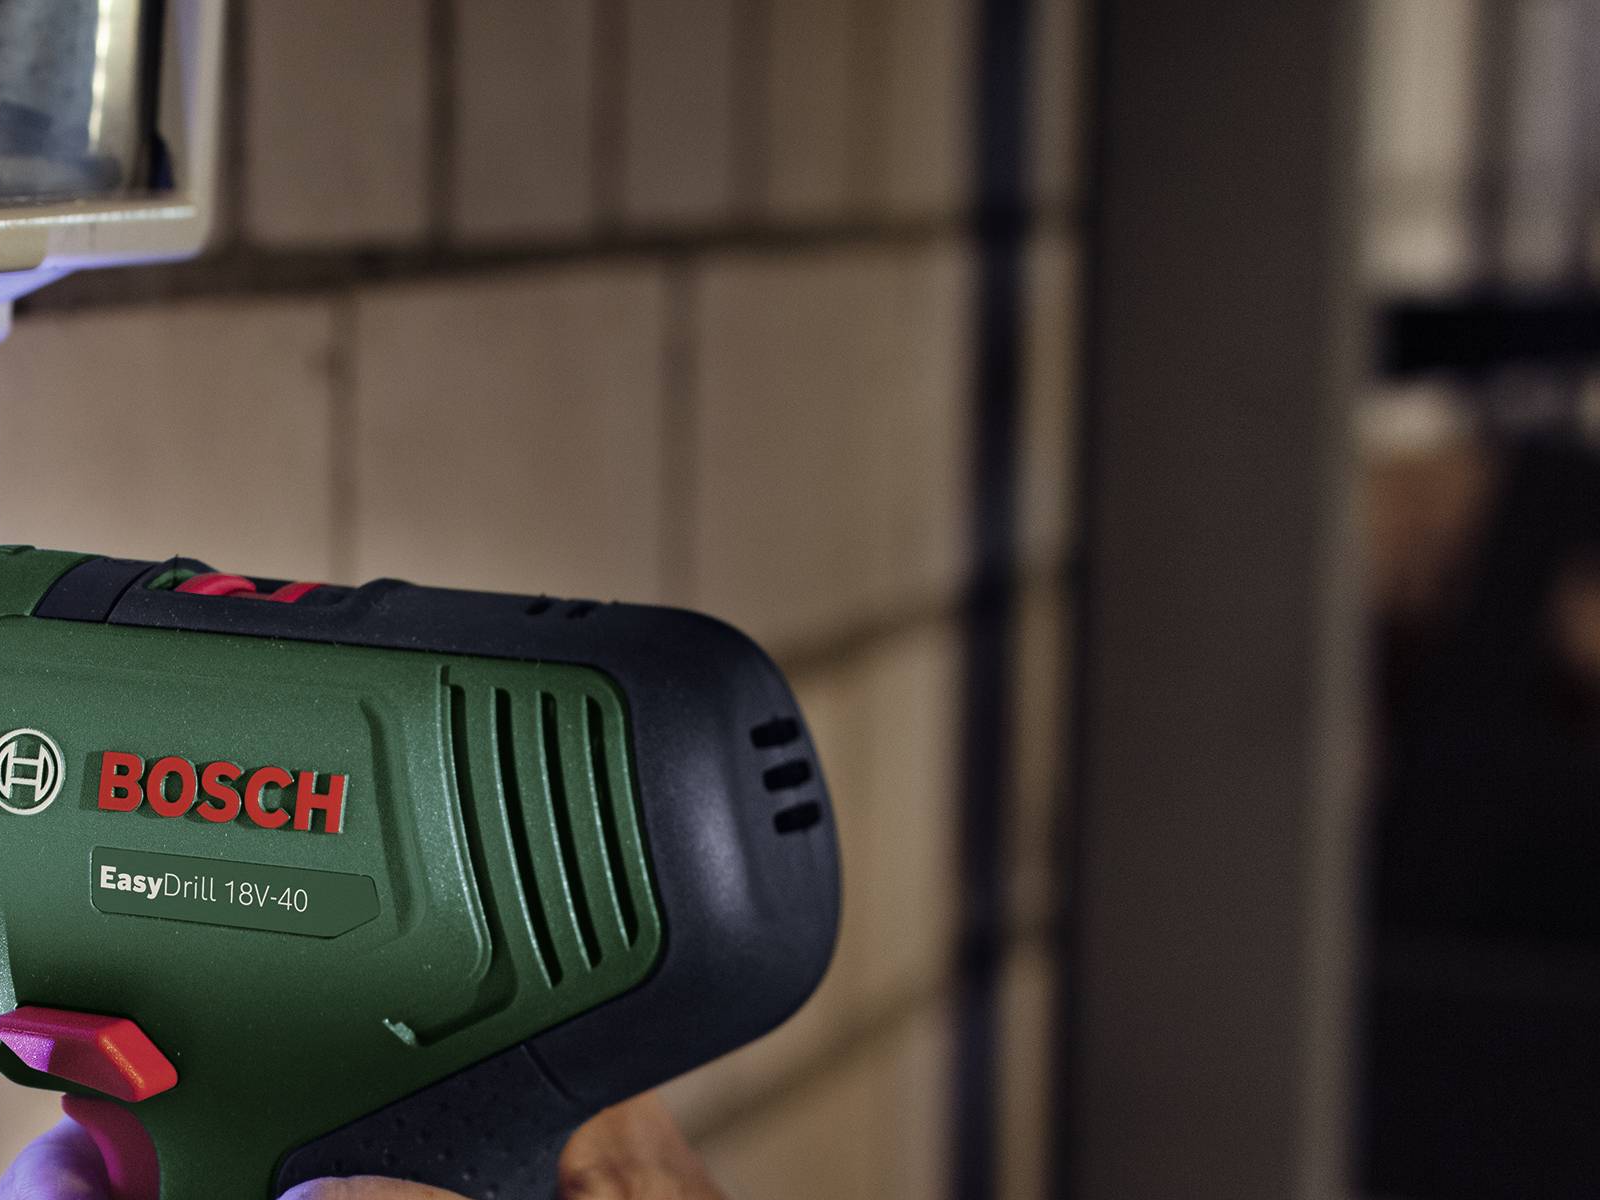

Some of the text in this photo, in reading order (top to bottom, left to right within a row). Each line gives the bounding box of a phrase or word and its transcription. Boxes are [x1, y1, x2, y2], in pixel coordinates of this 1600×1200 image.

[97, 751, 349, 833] BOSCH
[100, 865, 308, 912] EasyDrill 18V-40
